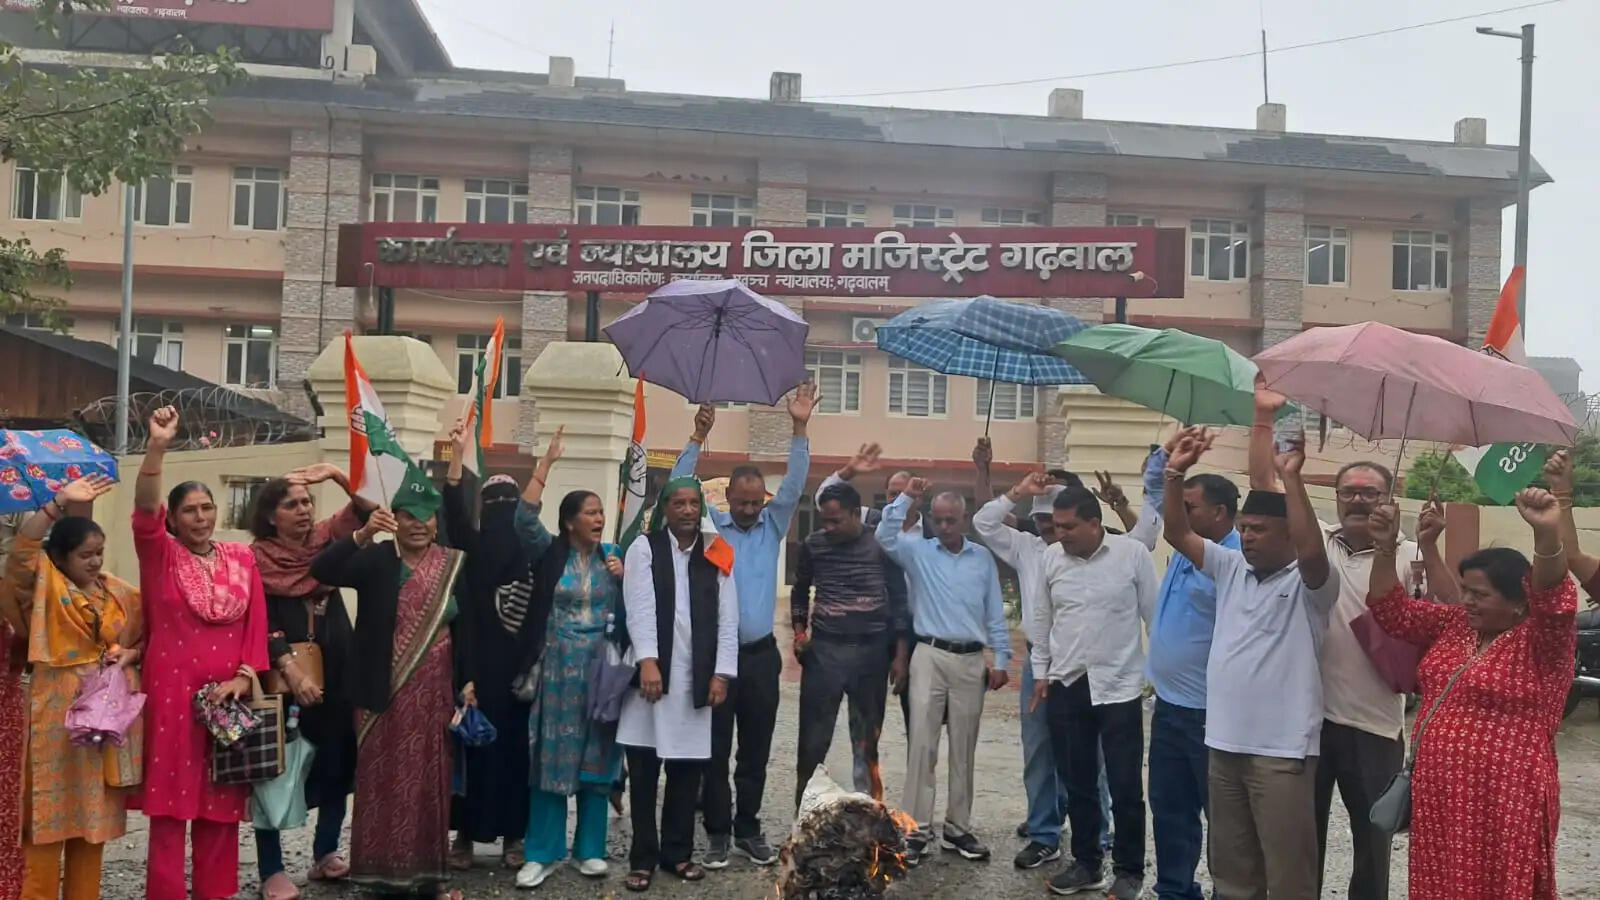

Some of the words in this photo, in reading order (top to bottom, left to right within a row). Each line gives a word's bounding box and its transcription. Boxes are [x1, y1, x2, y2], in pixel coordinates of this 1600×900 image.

[523, 229, 570, 268] एवं
[579, 239, 731, 269] न्यायालय
[743, 230, 834, 271] जिला
[842, 231, 992, 284] मजिस्ट्रेट
[999, 242, 1138, 281] गढ़वाल
